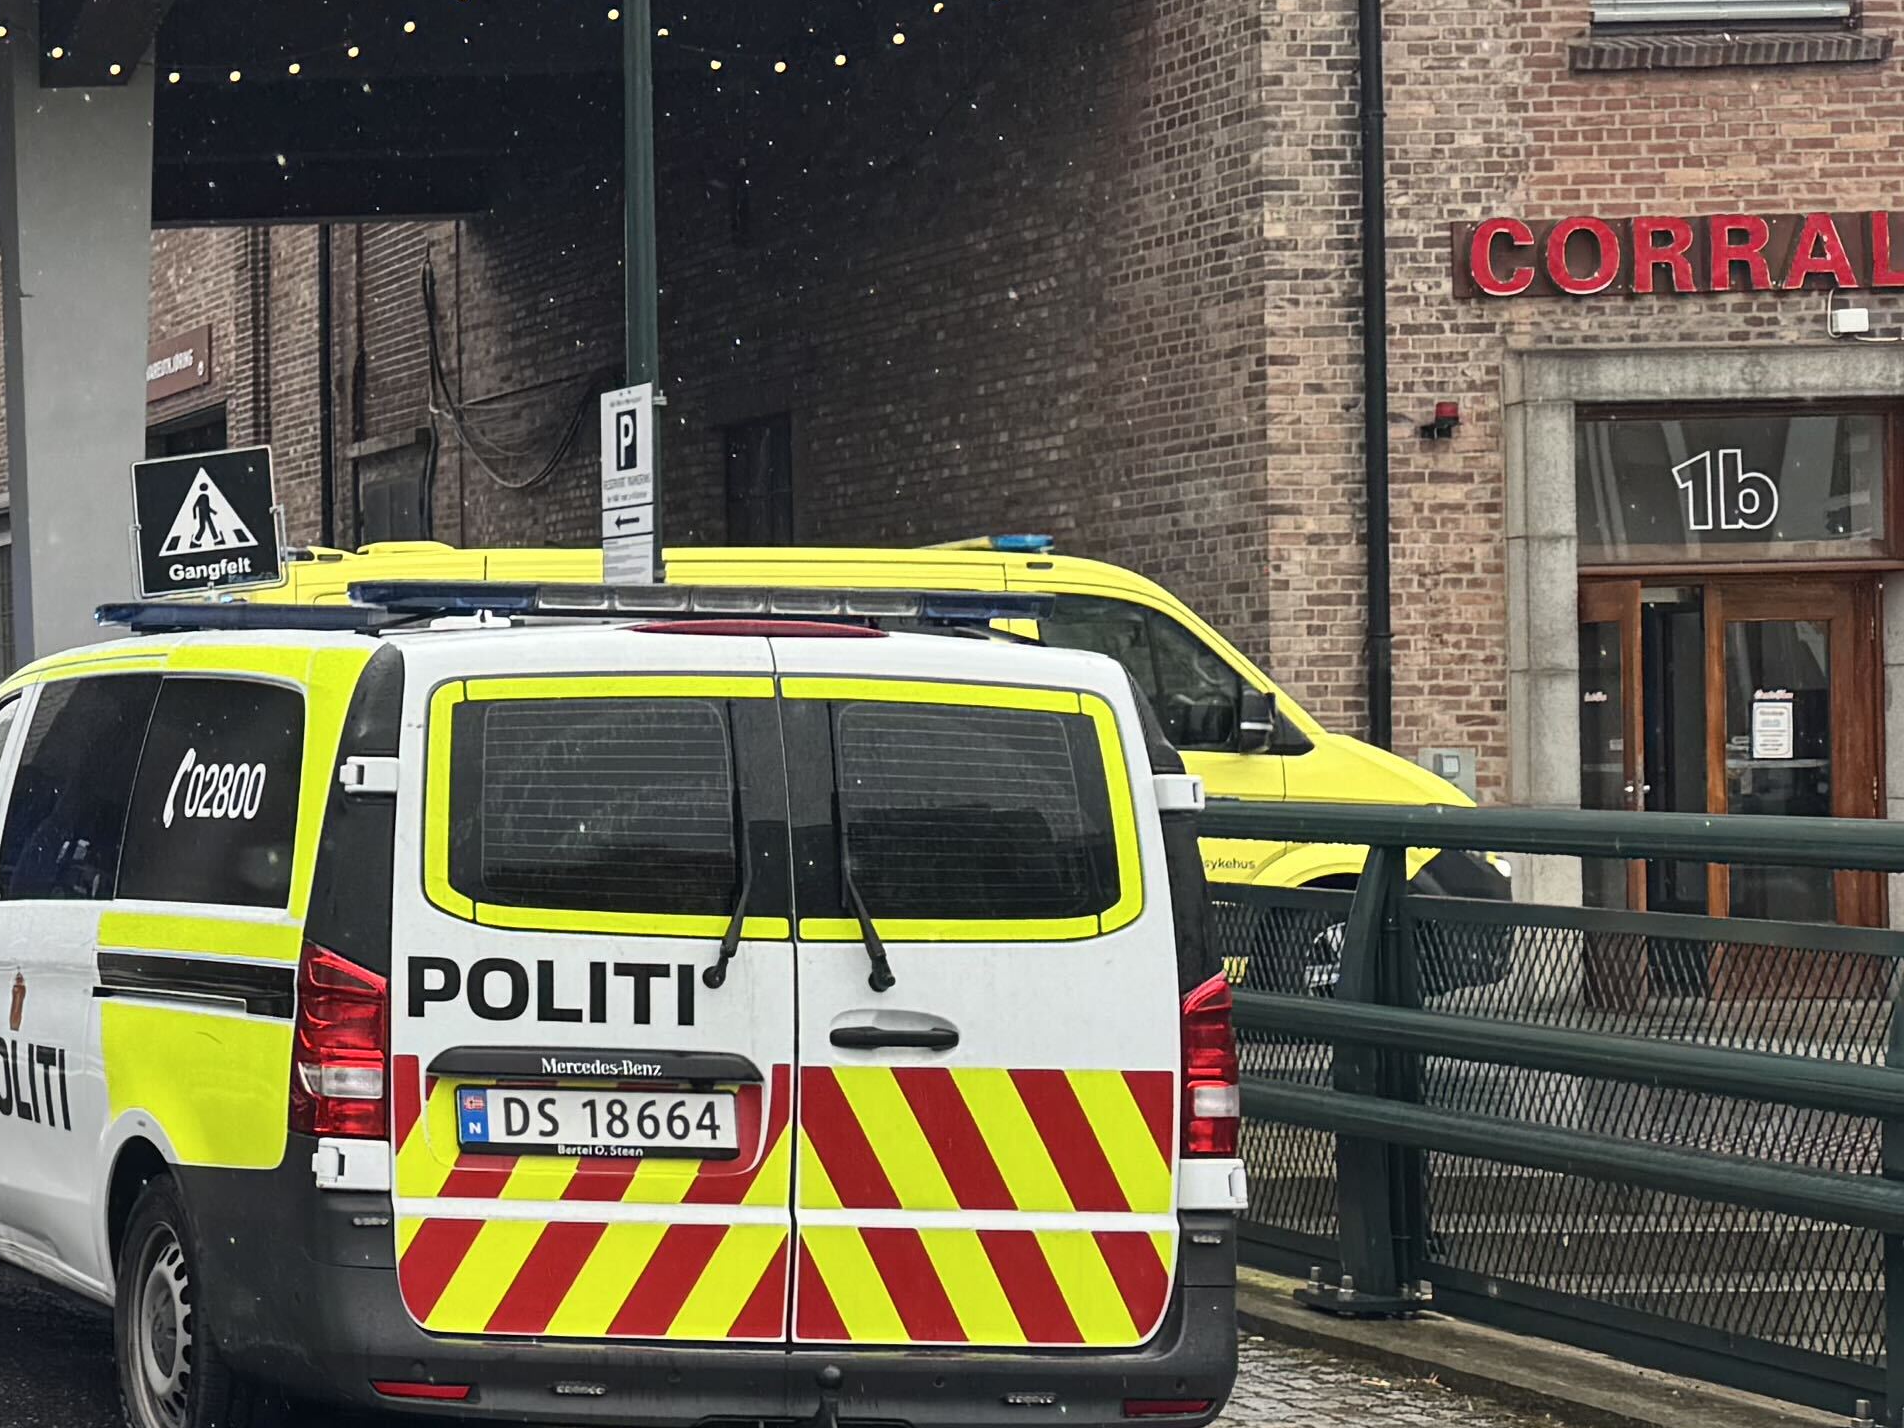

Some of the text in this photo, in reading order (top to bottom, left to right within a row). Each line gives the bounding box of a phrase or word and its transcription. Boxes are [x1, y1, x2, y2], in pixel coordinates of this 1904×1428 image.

[1470, 210, 1904, 296] CORRAL
[620, 414, 634, 468] P
[1672, 449, 1779, 531] 1b
[169, 556, 252, 583] Gangfelt
[184, 764, 267, 821] 02800
[407, 956, 695, 1027] POLITI
[541, 1057, 662, 1077] Mercedes-Benz
[469, 1122, 482, 1135] N
[504, 1097, 721, 1141] DS 18664
[557, 1144, 593, 1156] Bertel
[610, 1145, 644, 1157] Steen
